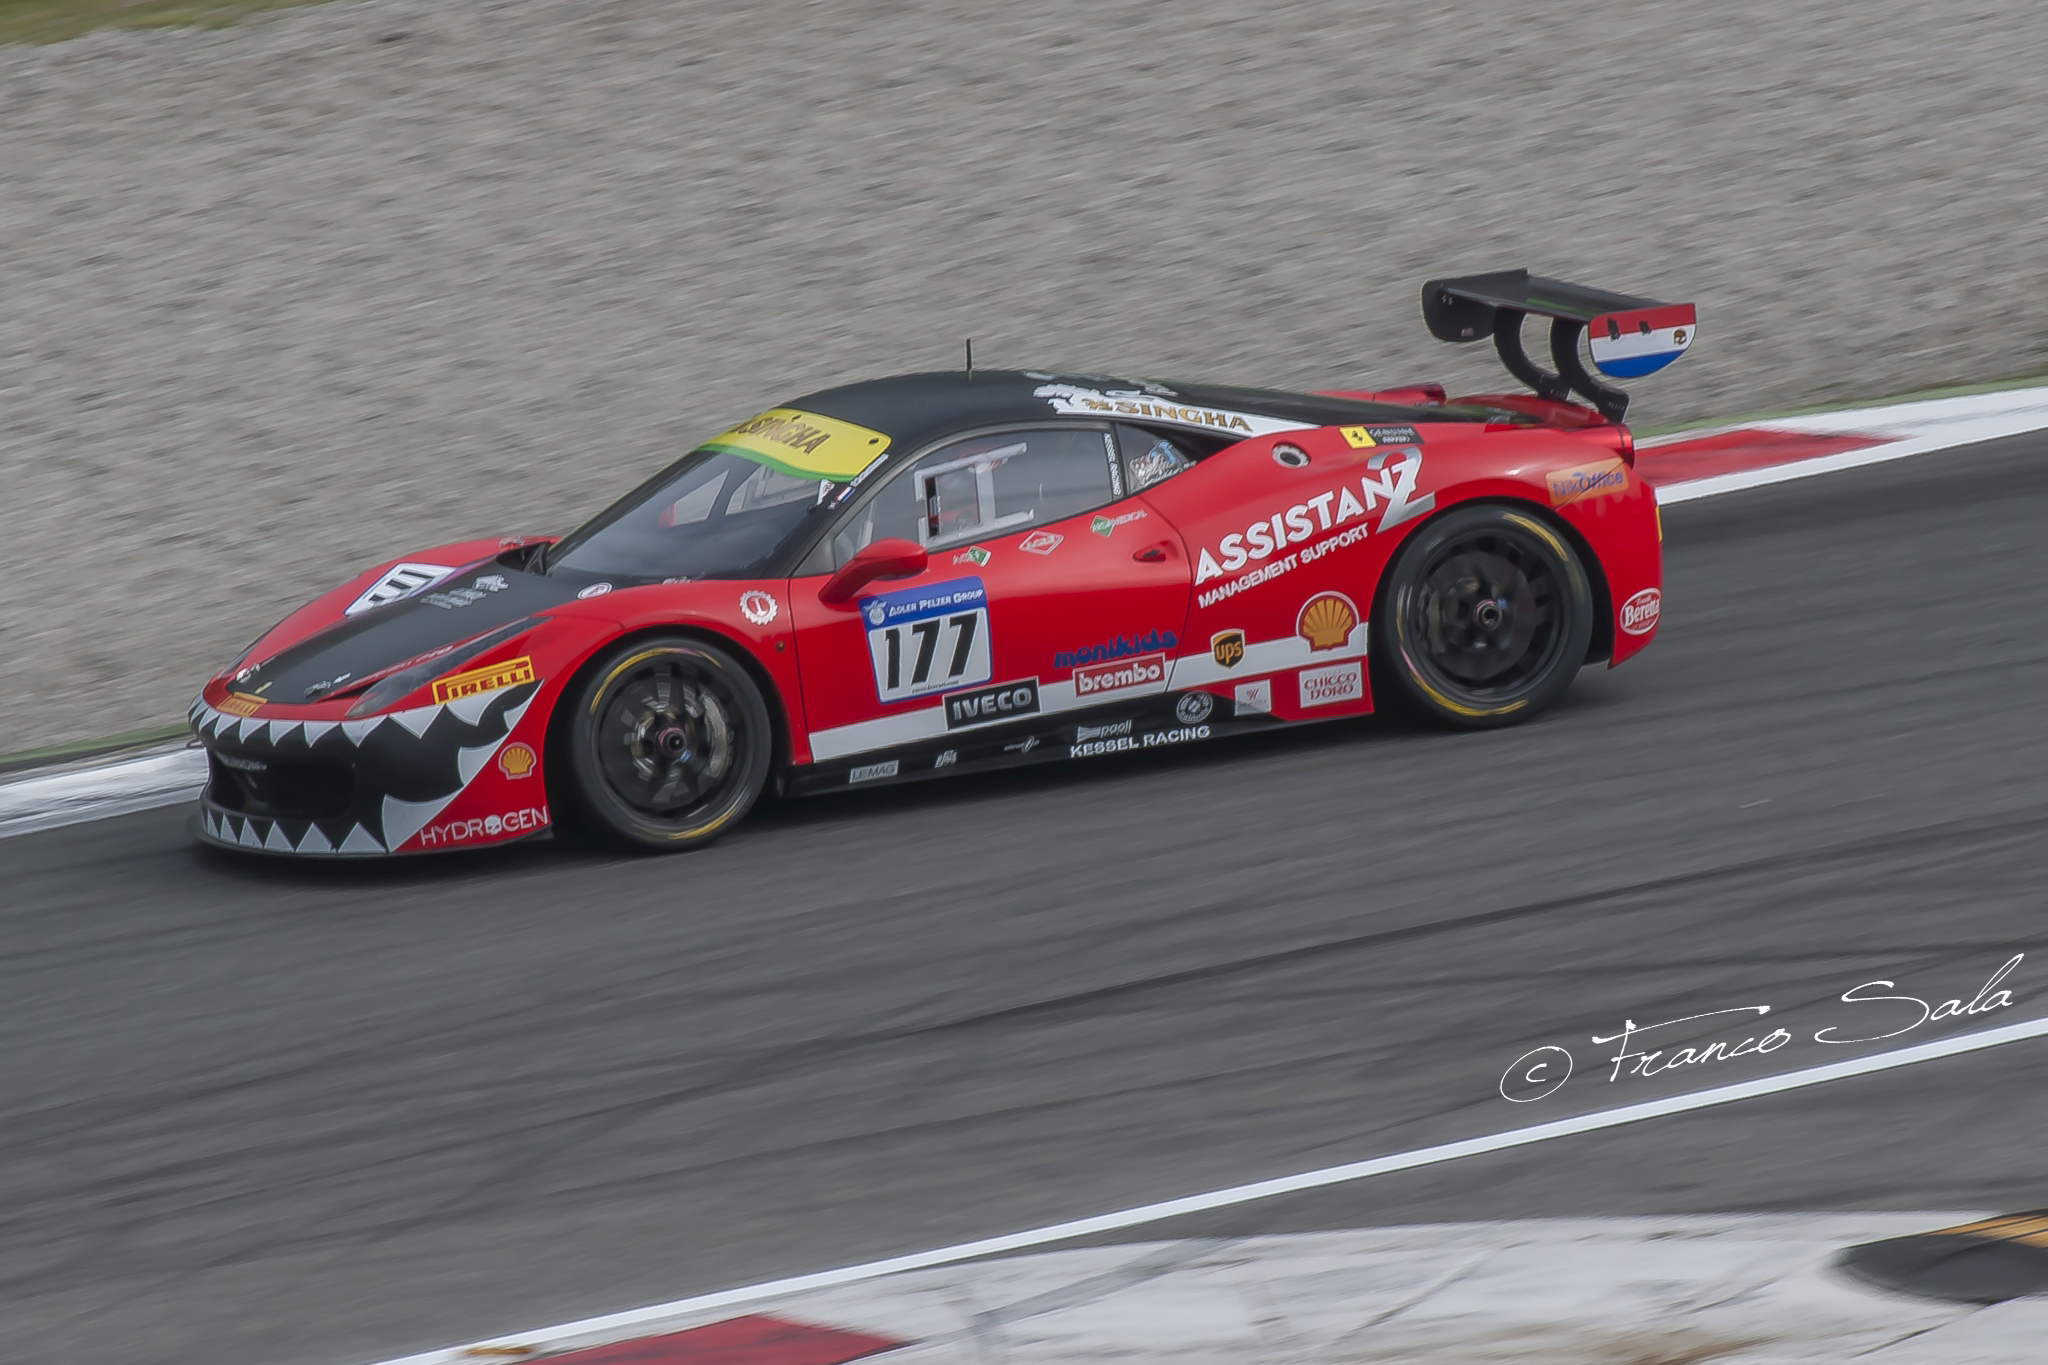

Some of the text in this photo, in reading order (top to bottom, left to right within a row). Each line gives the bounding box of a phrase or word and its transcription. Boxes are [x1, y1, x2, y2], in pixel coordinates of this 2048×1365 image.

[1115, 400, 1253, 432] SINGHA
[1198, 522, 1368, 608] MANAGEMENT SUPPORT
[919, 595, 951, 611] PELZER
[953, 589, 983, 603] GROUP
[1623, 598, 1660, 629] Beretta
[885, 611, 979, 691] 177
[1053, 628, 1178, 669] monikids
[1215, 641, 1242, 665] ups
[435, 660, 532, 702] PIRELLI
[1078, 662, 1160, 693] brembo
[1304, 671, 1357, 691] CHICCO
[952, 687, 1032, 721] IVECO
[1070, 725, 1210, 758] KESSEL RACING
[420, 805, 549, 846] HYDROGEN
